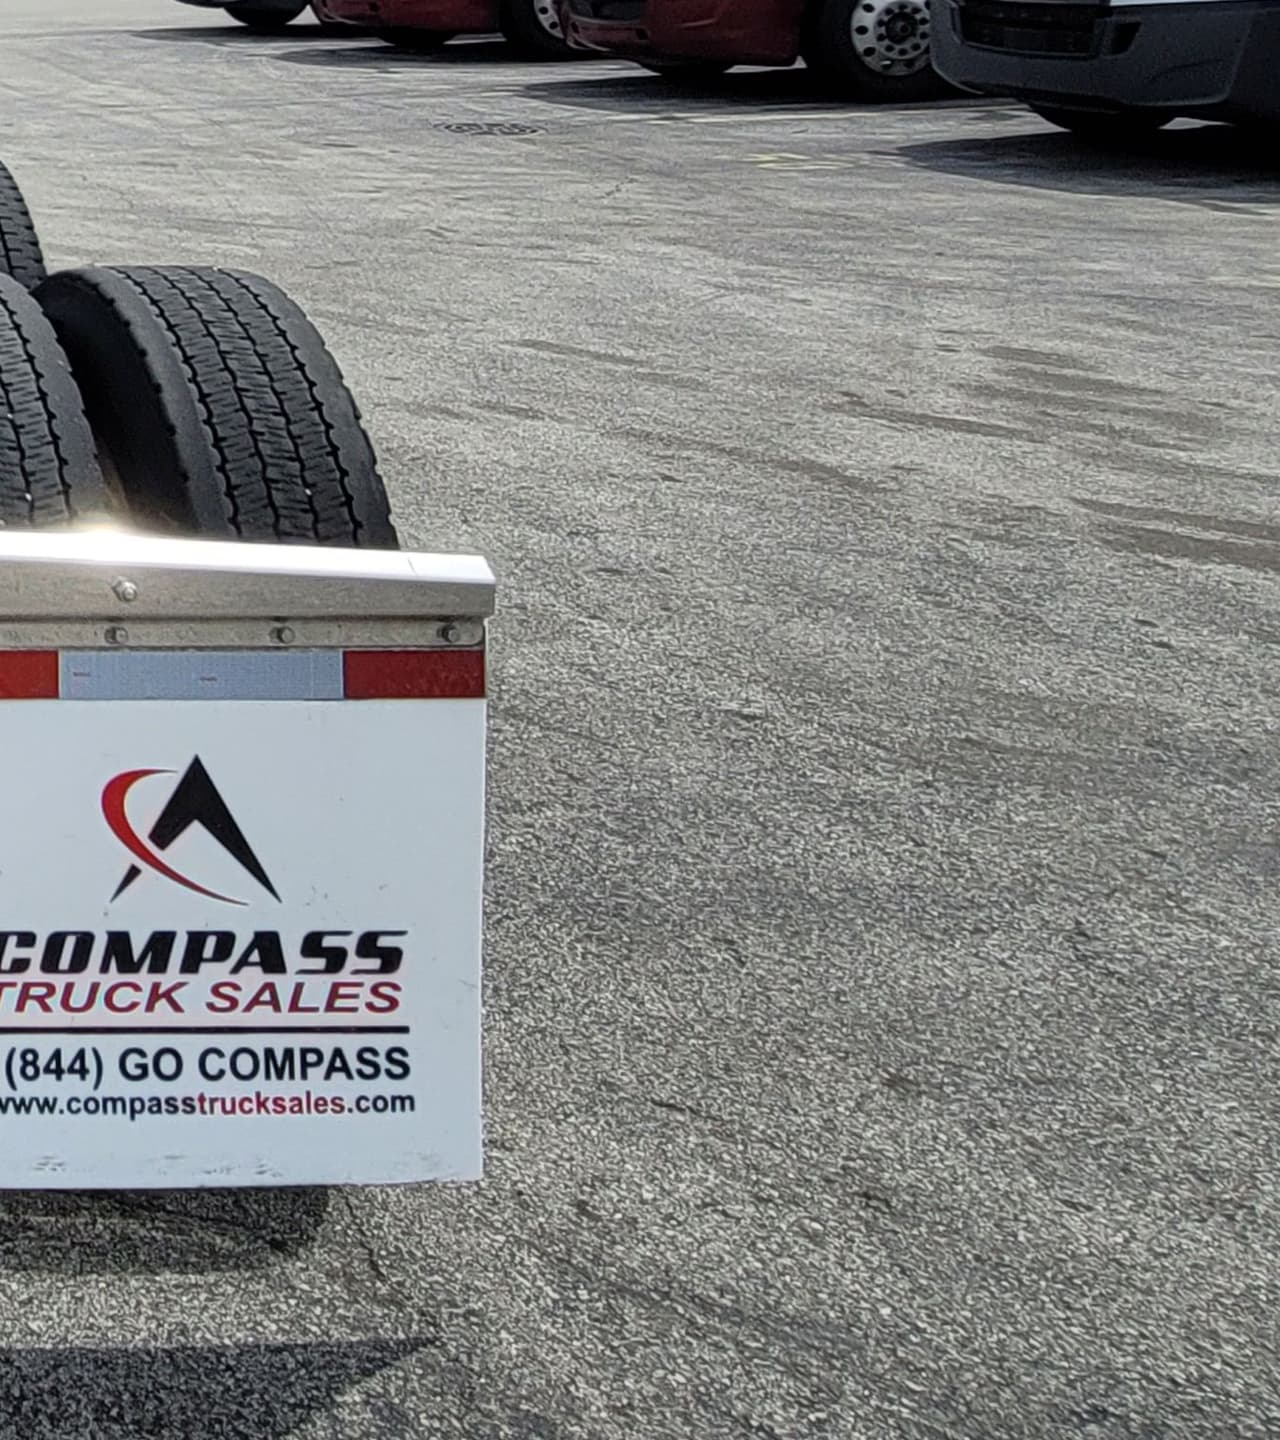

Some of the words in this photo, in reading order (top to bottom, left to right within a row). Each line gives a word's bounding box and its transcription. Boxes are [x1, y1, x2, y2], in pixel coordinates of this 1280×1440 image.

[205, 981, 402, 1014] SALES
[118, 1046, 184, 1082] GO
[197, 1046, 411, 1082] COMPASS
